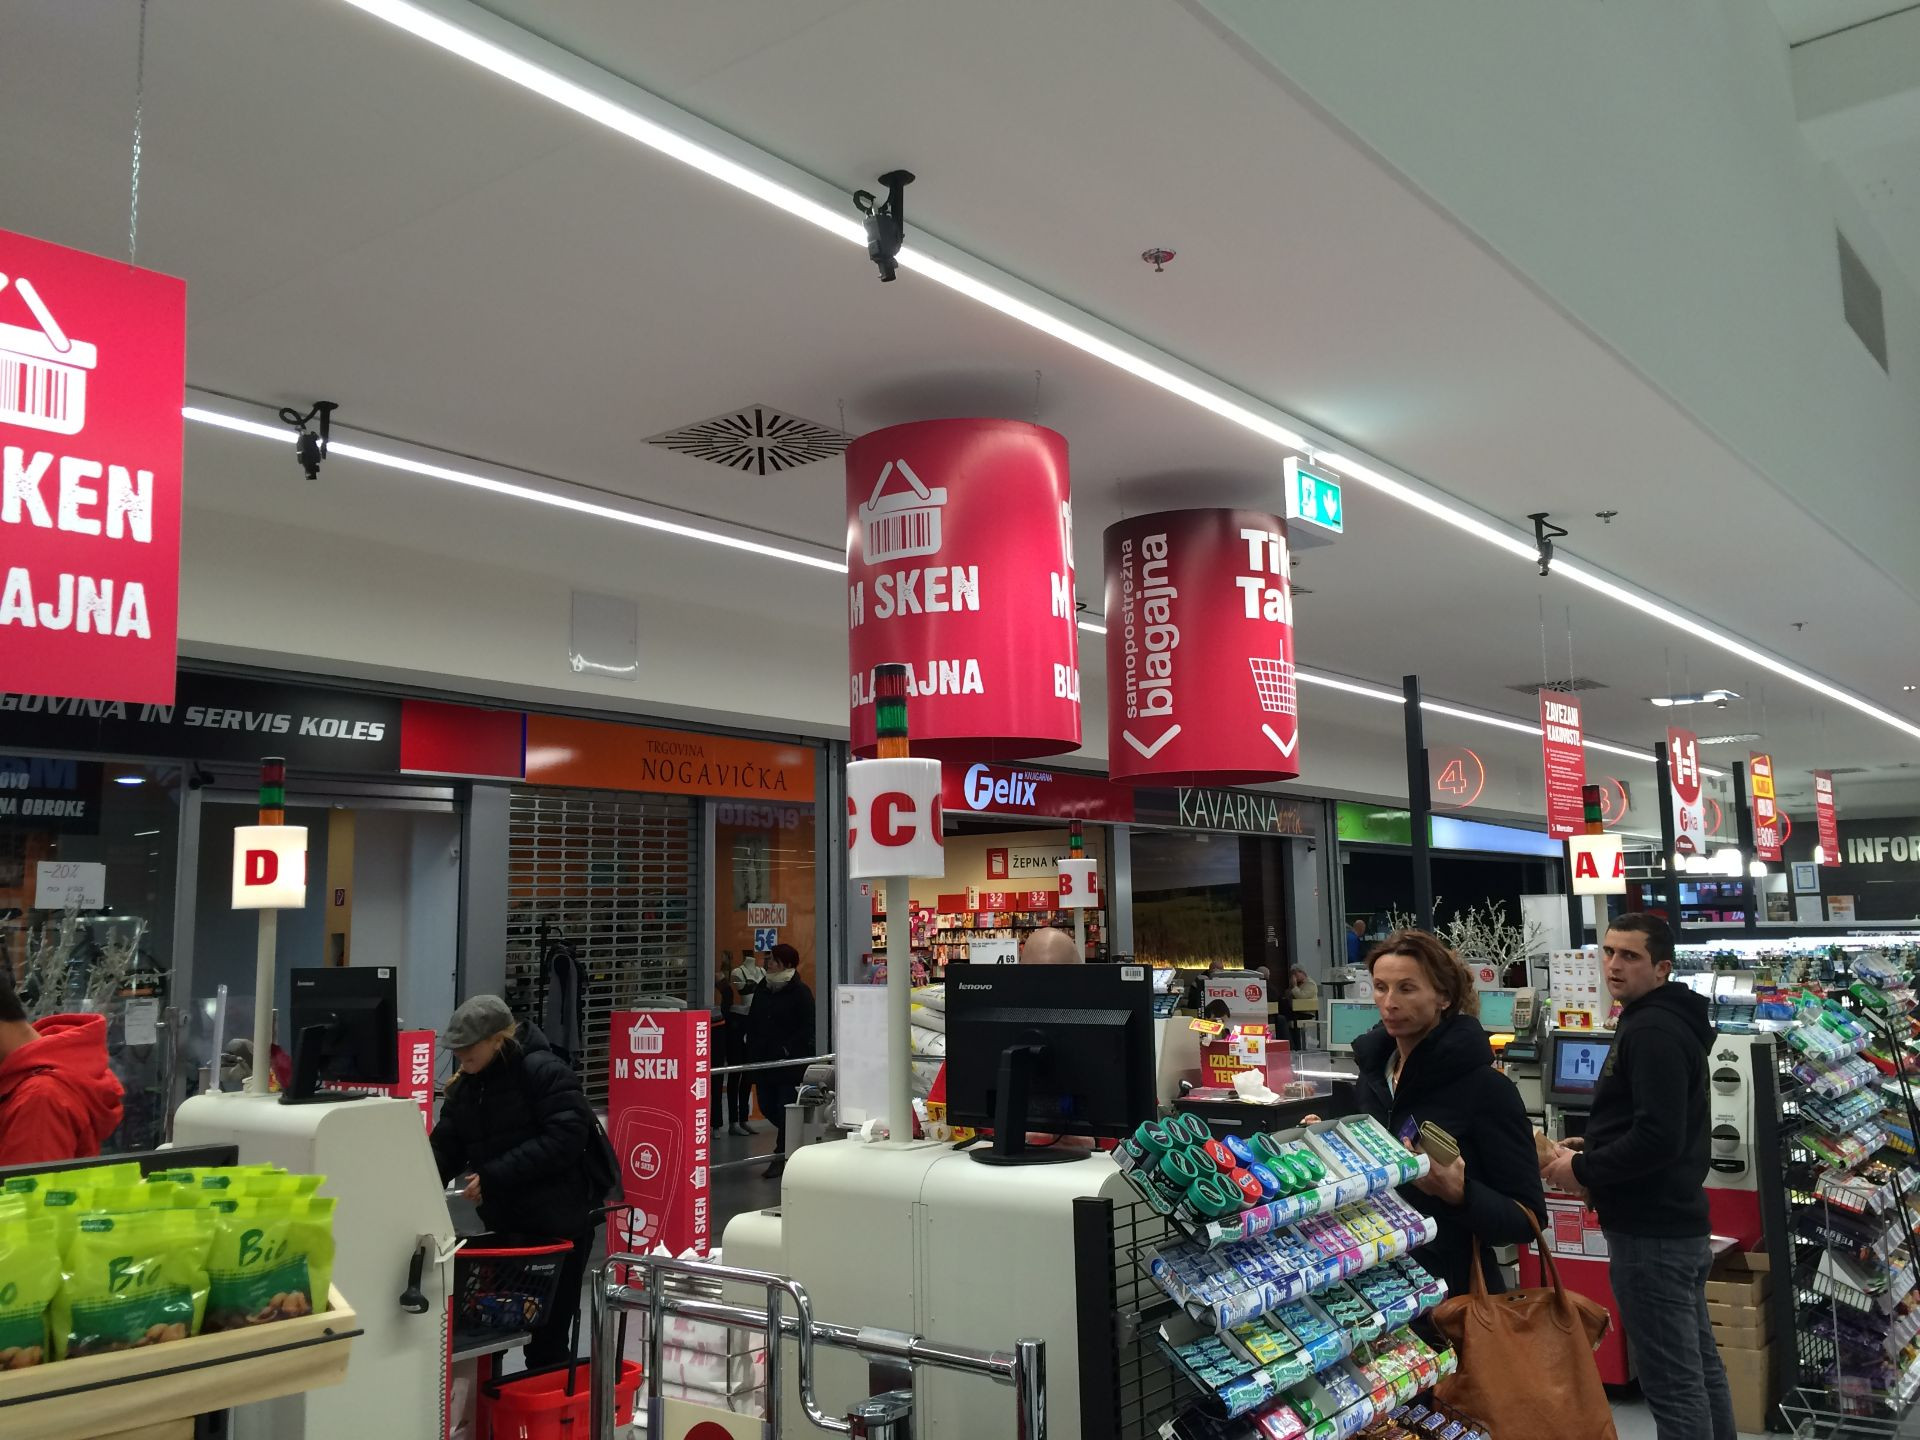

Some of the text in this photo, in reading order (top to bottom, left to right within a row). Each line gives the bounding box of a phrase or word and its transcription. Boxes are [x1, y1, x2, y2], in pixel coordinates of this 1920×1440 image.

[2, 446, 154, 543] KEN
[0, 567, 151, 639] AJNA
[875, 565, 980, 618] SKEN
[1121, 538, 1139, 719] samopostrežna
[1136, 532, 1180, 718] blagajna
[0, 692, 386, 742] GOVINA IN SERVIS KOLES
[646, 740, 705, 759] TRGOVINA
[641, 757, 788, 793] NOGAVIČKA
[964, 763, 1037, 811] Felix
[1437, 760, 1467, 794] 4
[21, 798, 86, 817] OBROKE
[871, 792, 916, 847] C
[1178, 787, 1282, 833] KAVARNA
[1013, 854, 1048, 868] ŽEPNA
[1575, 852, 1599, 879] A
[1847, 836, 1920, 863] INFOR
[245, 850, 279, 886] D
[1059, 873, 1073, 896] B
[748, 905, 785, 926] NEDRČKI
[754, 929, 777, 952] 5€
[1006, 955, 1015, 963] 69
[959, 982, 993, 990] lenovo
[1208, 988, 1239, 998] Tefal
[412, 1043, 430, 1085] SKEN
[696, 1021, 708, 1072] M SKEN
[1209, 1055, 1255, 1068] IZDEL
[615, 1058, 678, 1080] M SKEN
[695, 1108, 707, 1161] M SKEN
[695, 1197, 707, 1250] M SKEN
[1247, 1212, 1269, 1238] Orbit
[240, 1228, 288, 1267] Bio
[109, 1256, 162, 1293] Bio
[1221, 1304, 1243, 1329] Orbit
